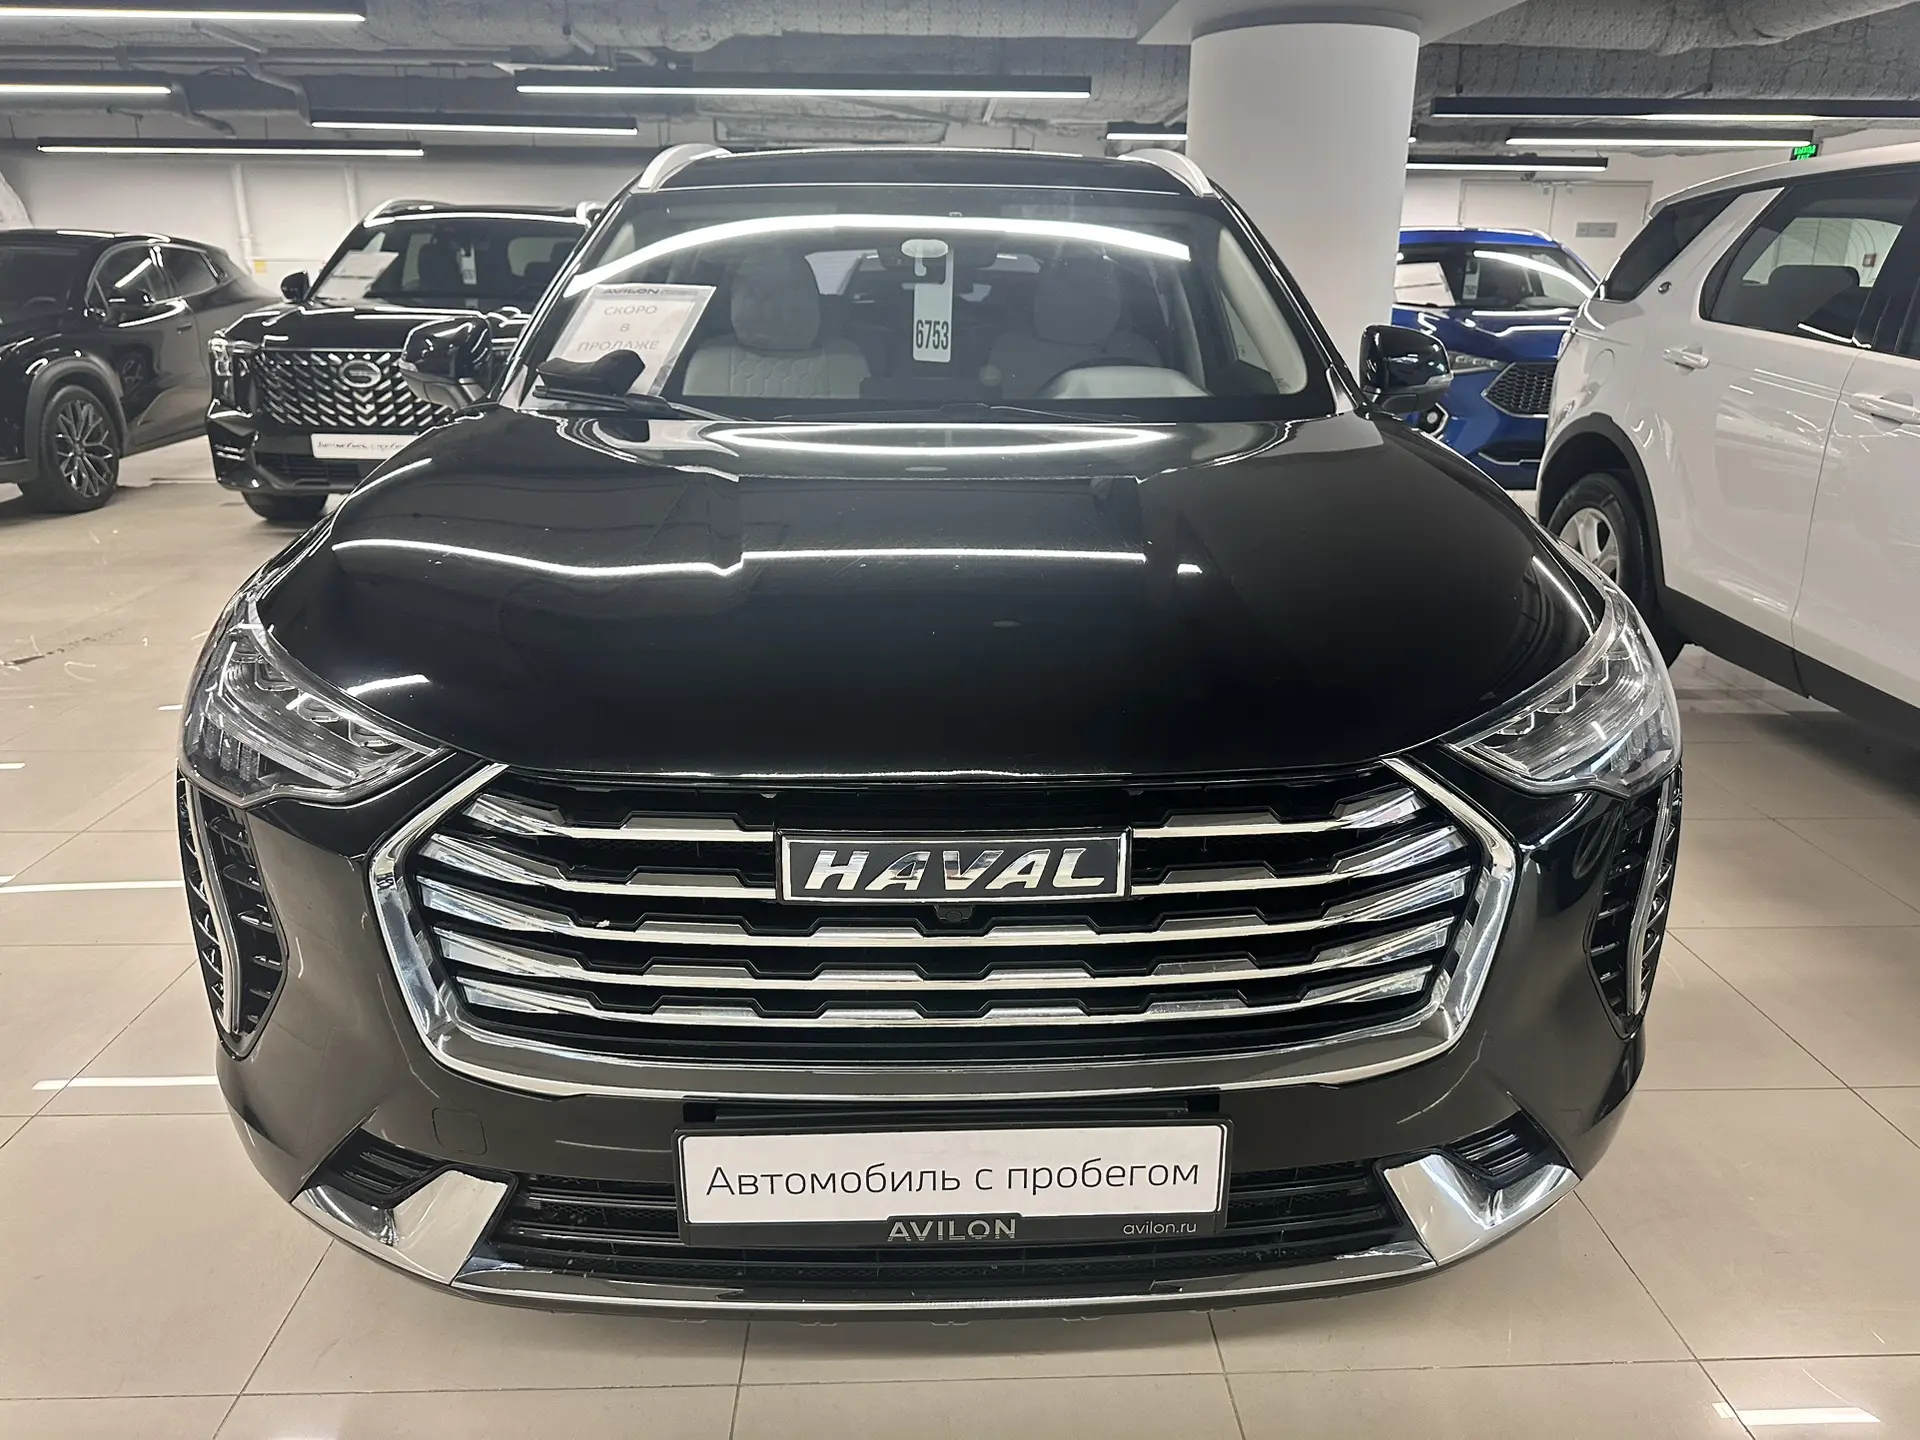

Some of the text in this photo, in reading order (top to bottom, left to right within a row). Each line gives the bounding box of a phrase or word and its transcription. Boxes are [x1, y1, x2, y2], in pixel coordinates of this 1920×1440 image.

[604, 305, 658, 316] СКОРО
[619, 323, 630, 333] В
[915, 319, 949, 350] 6753
[803, 847, 1105, 891] HAVAL
[706, 1157, 1199, 1196] Автомобиль с пробегом
[887, 1218, 1016, 1242] AVILON
[1122, 1220, 1197, 1236] avilon.ru
